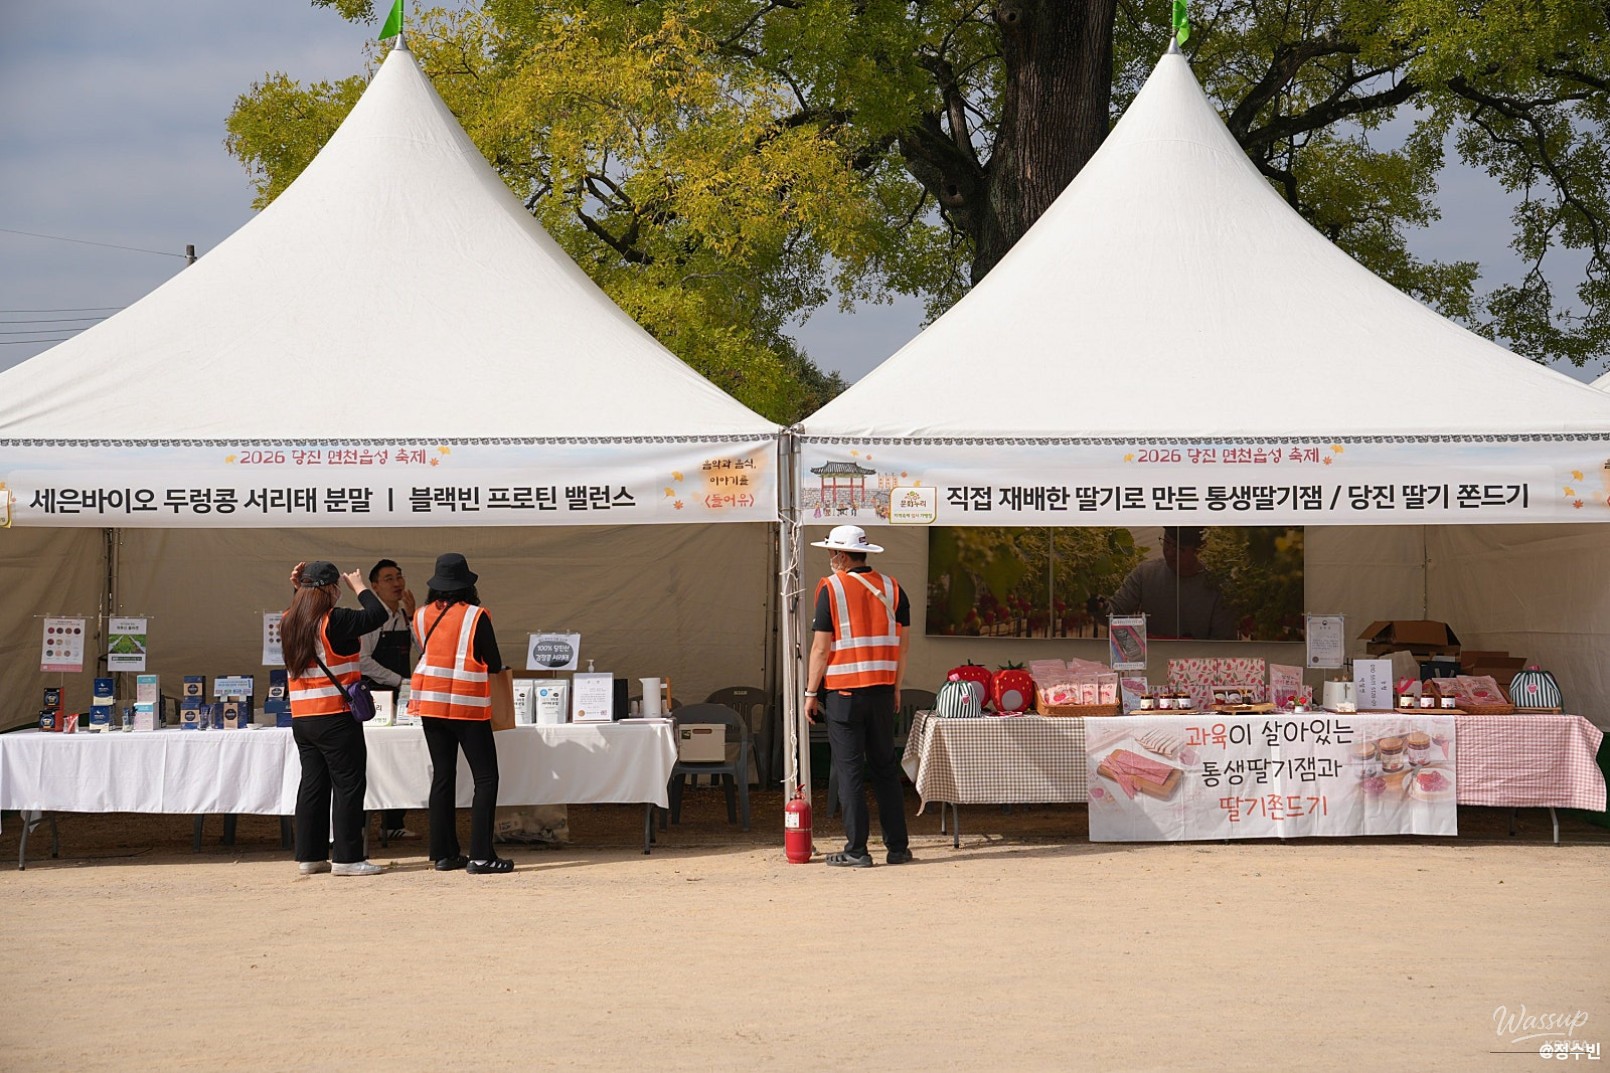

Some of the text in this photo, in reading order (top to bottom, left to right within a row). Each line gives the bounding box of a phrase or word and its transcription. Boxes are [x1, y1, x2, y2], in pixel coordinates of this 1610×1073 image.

[240, 448, 426, 465] 2026 당진 면천읍성 축제
[1138, 447, 1320, 464] 2026 당진 면천읍성 축제
[710, 475, 749, 486] 이야기를
[30, 488, 157, 514] 세은바이오
[163, 488, 239, 514] 두렁콩
[243, 487, 317, 513] 서리태
[323, 487, 373, 513] 분말
[408, 486, 480, 512] 블랙빈
[486, 486, 557, 511] 프로틴
[565, 485, 636, 511] 밸런스
[946, 486, 992, 512] 직접
[998, 486, 1071, 512] 재배한
[1075, 486, 1146, 512] 딸기로
[1152, 486, 1200, 511] 만든
[1204, 485, 1322, 511] 통생딸기잼
[1348, 484, 1395, 510] 당진
[1402, 484, 1449, 510] 딸기
[1456, 483, 1529, 509] 쫀드기
[1185, 719, 1355, 750] 과육이 살아있는
[1201, 757, 1343, 788] 통생딸기잼과
[1219, 794, 1328, 823] 딸기쫀드기
